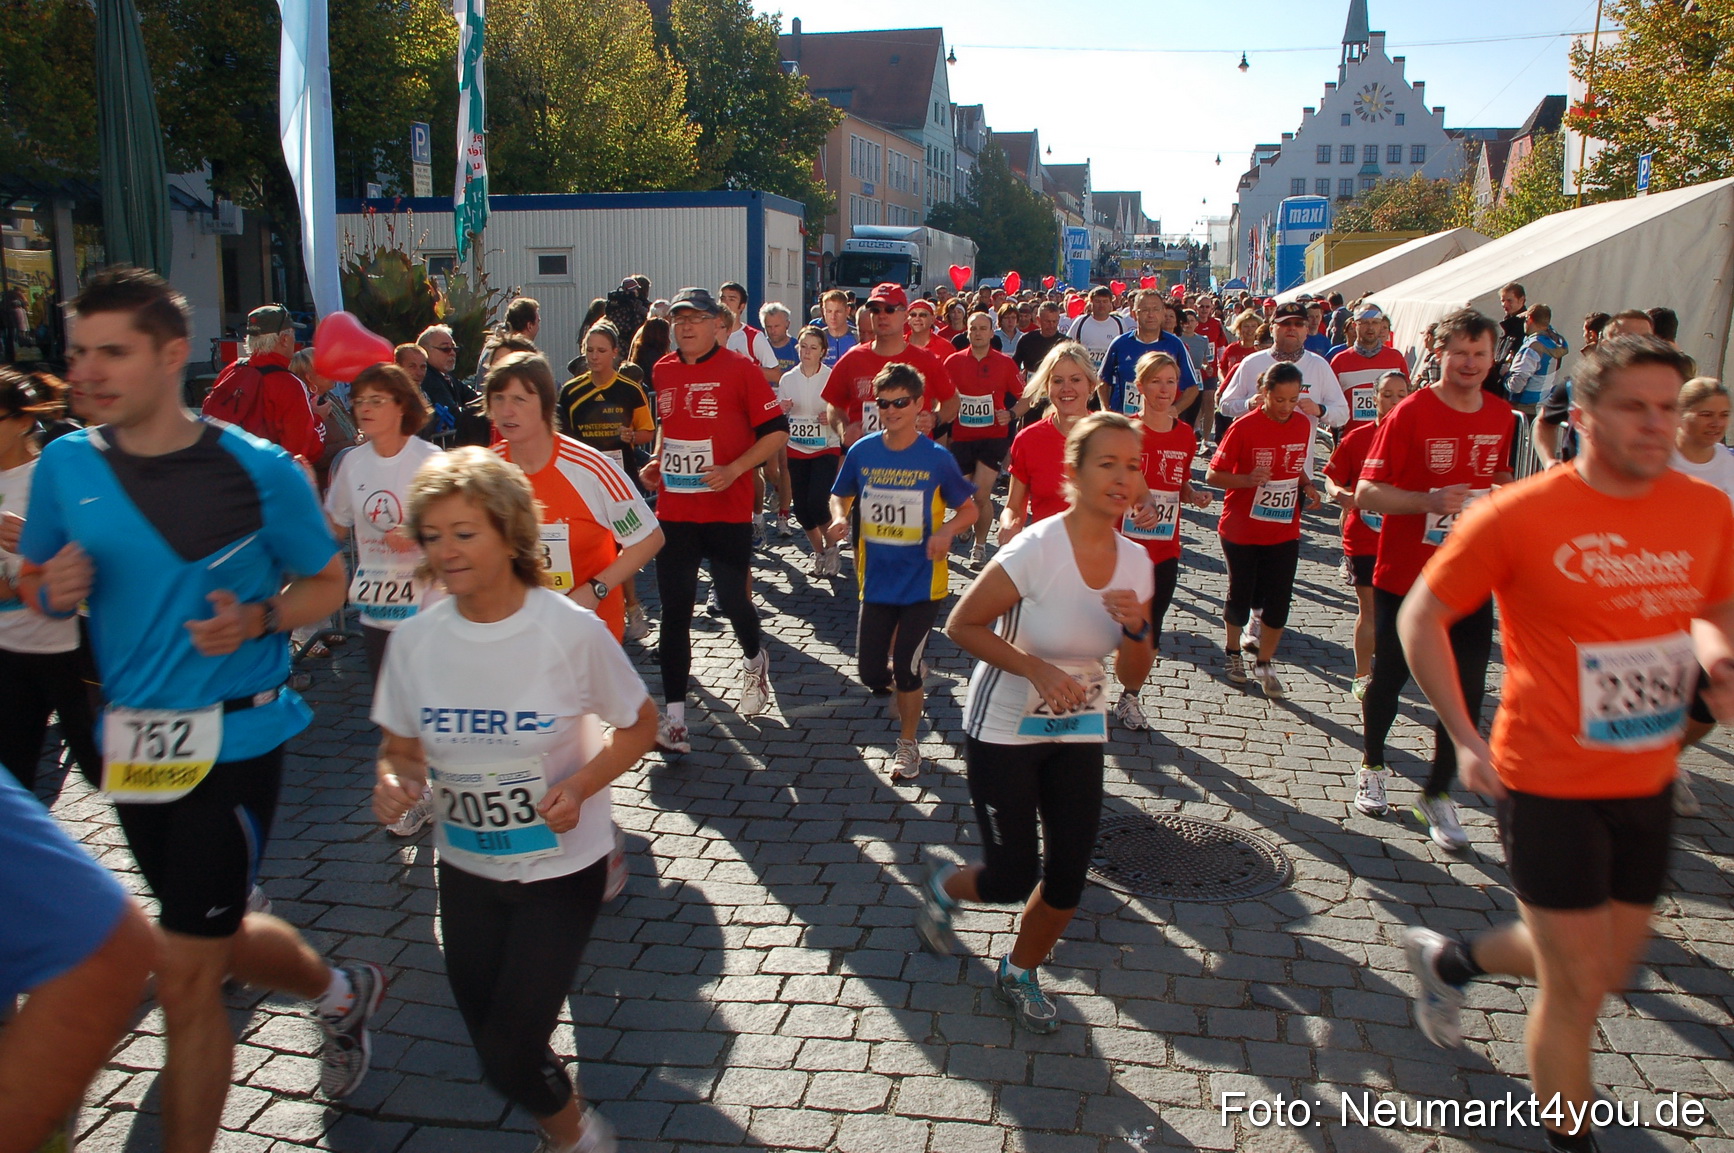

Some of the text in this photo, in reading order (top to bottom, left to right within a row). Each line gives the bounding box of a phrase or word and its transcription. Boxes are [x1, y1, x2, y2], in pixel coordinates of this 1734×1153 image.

[415, 127, 426, 157] P
[1640, 158, 1649, 186] P
[1289, 205, 1325, 224] maxi
[962, 404, 990, 416] 2040
[968, 416, 983, 424] Jens
[791, 424, 821, 437] 2821
[665, 452, 707, 474] 2912
[867, 476, 917, 487] STADTLAUF
[871, 467, 930, 480] NEUMARKTER
[1260, 491, 1297, 508] 2567
[871, 503, 906, 526] 301
[876, 525, 904, 537] Erika
[357, 580, 415, 604] 2724
[421, 707, 508, 735] PETER
[125, 717, 196, 761] 752
[436, 736, 520, 746] electronic
[441, 787, 536, 828] 2053
[476, 830, 512, 850] Elli
